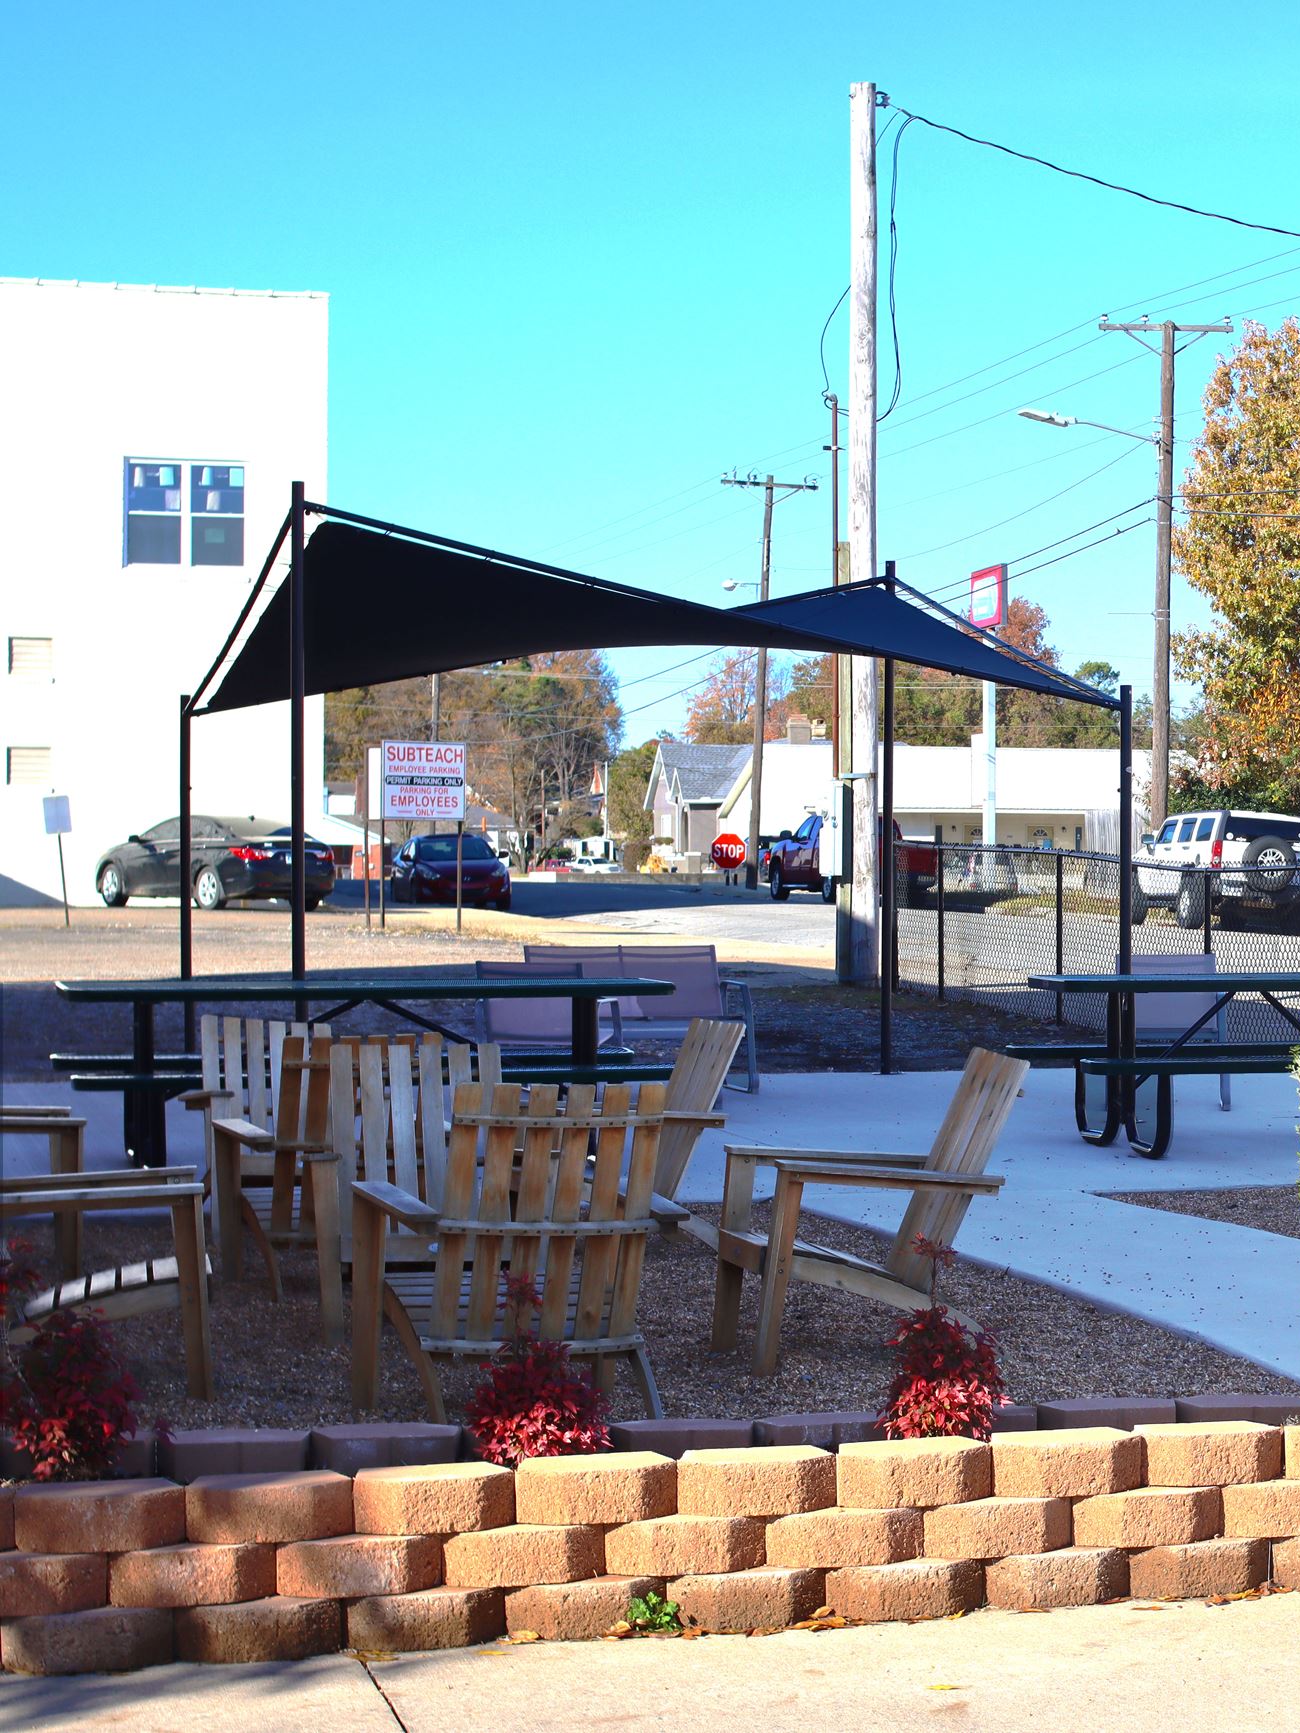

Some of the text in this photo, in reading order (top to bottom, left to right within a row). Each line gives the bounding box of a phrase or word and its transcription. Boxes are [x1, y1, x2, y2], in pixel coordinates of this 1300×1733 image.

[387, 745, 463, 763] SUBTEACH
[388, 765, 460, 775] EMPLOYEE PARKING
[386, 777, 462, 787] PERMIT PARKING ONLY
[400, 786, 448, 795] PARKING FOR
[391, 795, 458, 808] EMPLOYEES
[416, 808, 435, 817] ONLY
[713, 844, 744, 858] STOP
